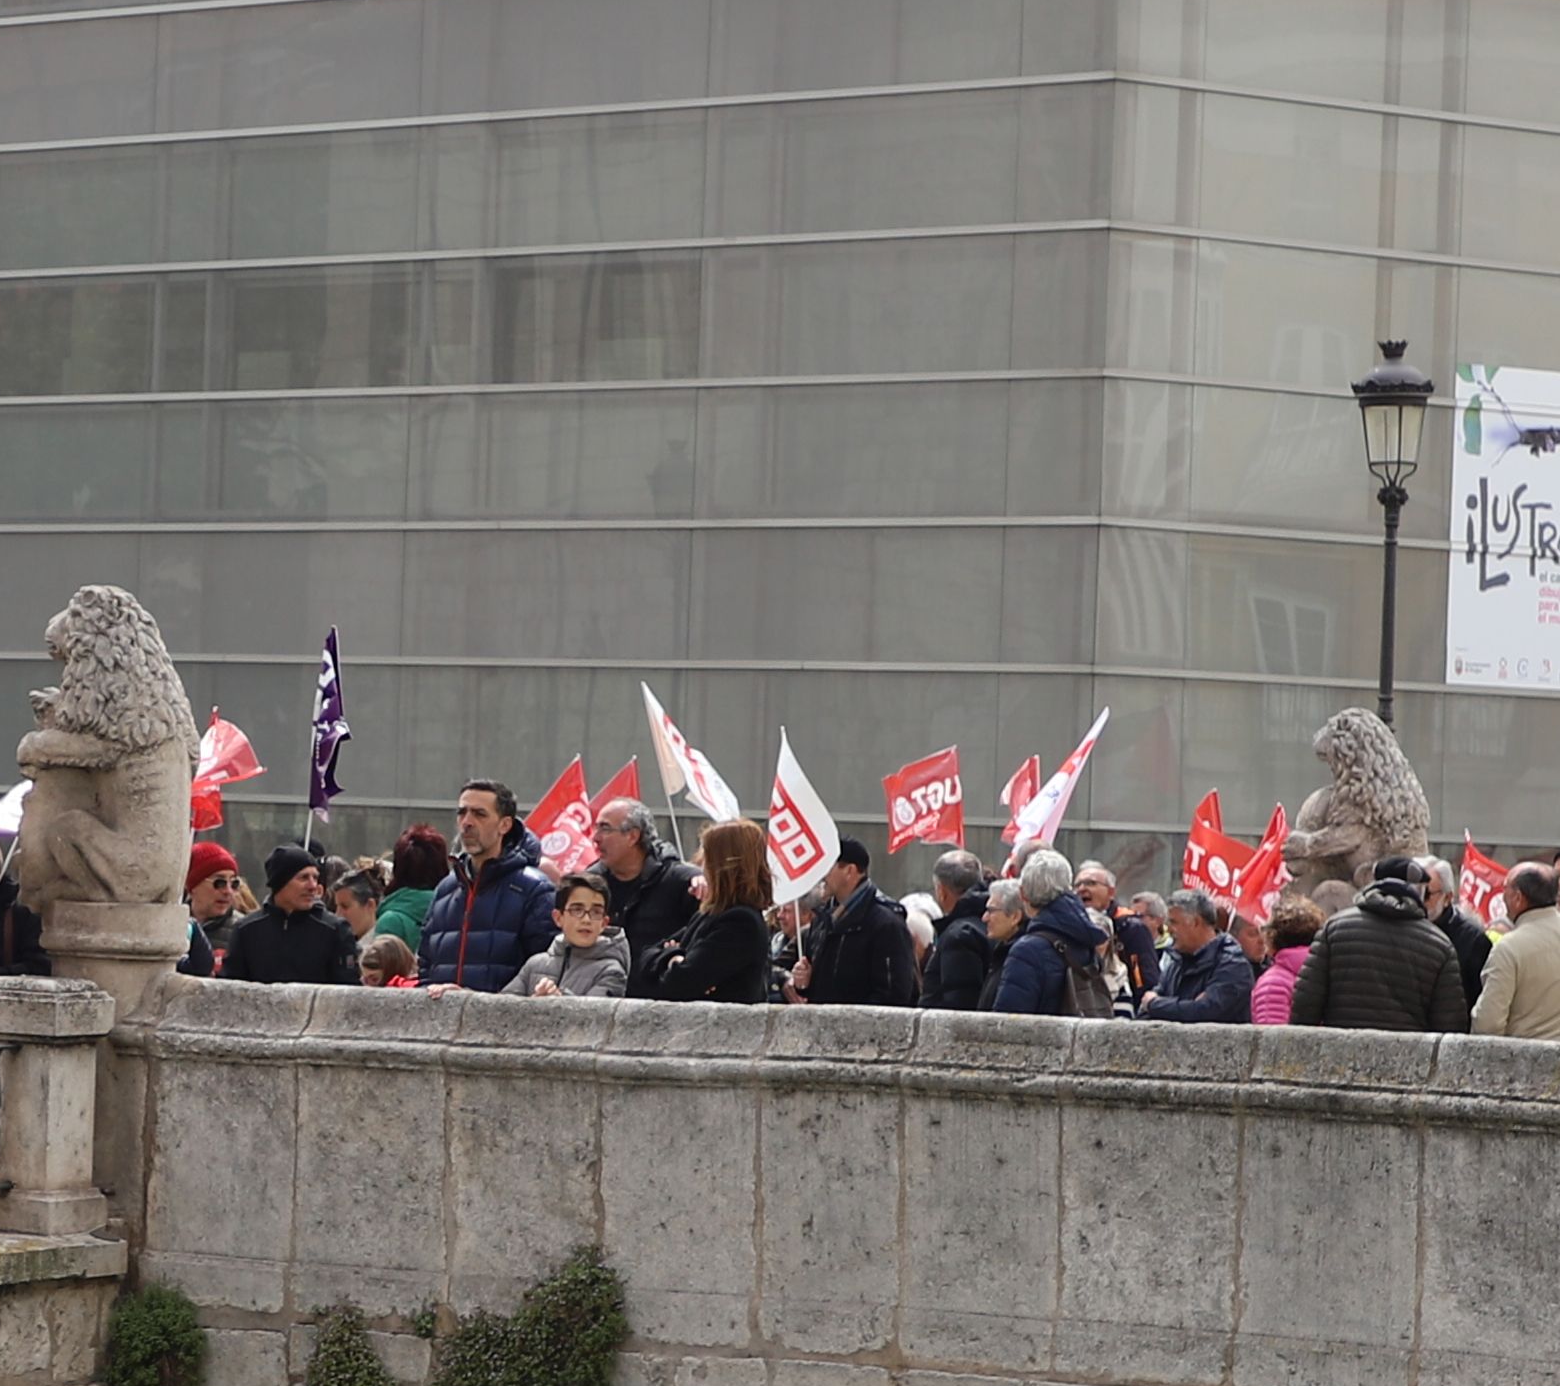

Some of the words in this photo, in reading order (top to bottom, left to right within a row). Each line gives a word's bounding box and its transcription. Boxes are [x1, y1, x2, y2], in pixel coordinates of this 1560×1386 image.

[1539, 572, 1547, 582] el
[1538, 601, 1558, 612] para
[1538, 613, 1546, 624] el
